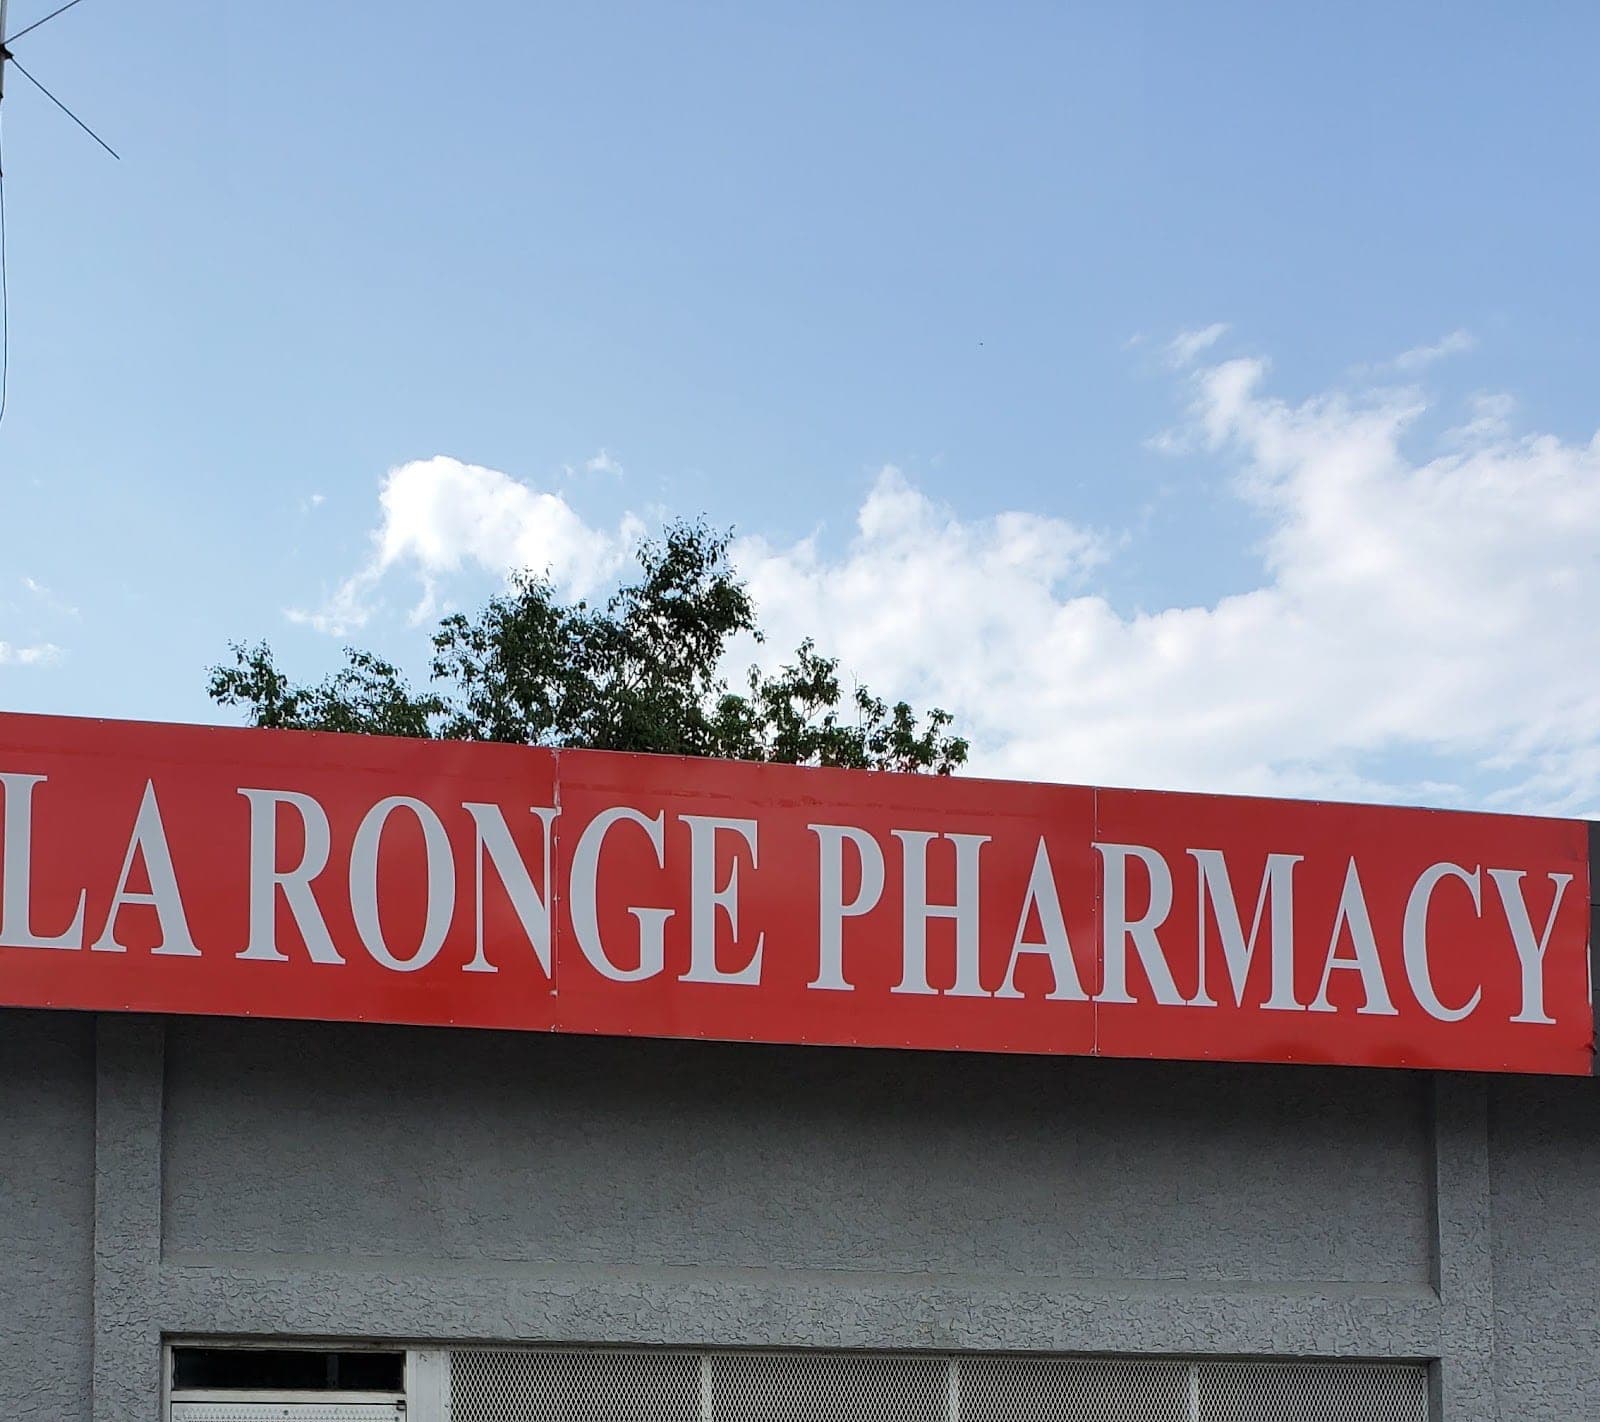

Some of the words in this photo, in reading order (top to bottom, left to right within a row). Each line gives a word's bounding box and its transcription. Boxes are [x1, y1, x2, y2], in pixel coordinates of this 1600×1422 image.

[0, 771, 203, 957] LA
[234, 786, 765, 987] RONGE
[806, 823, 1574, 1025] PHARMACY
